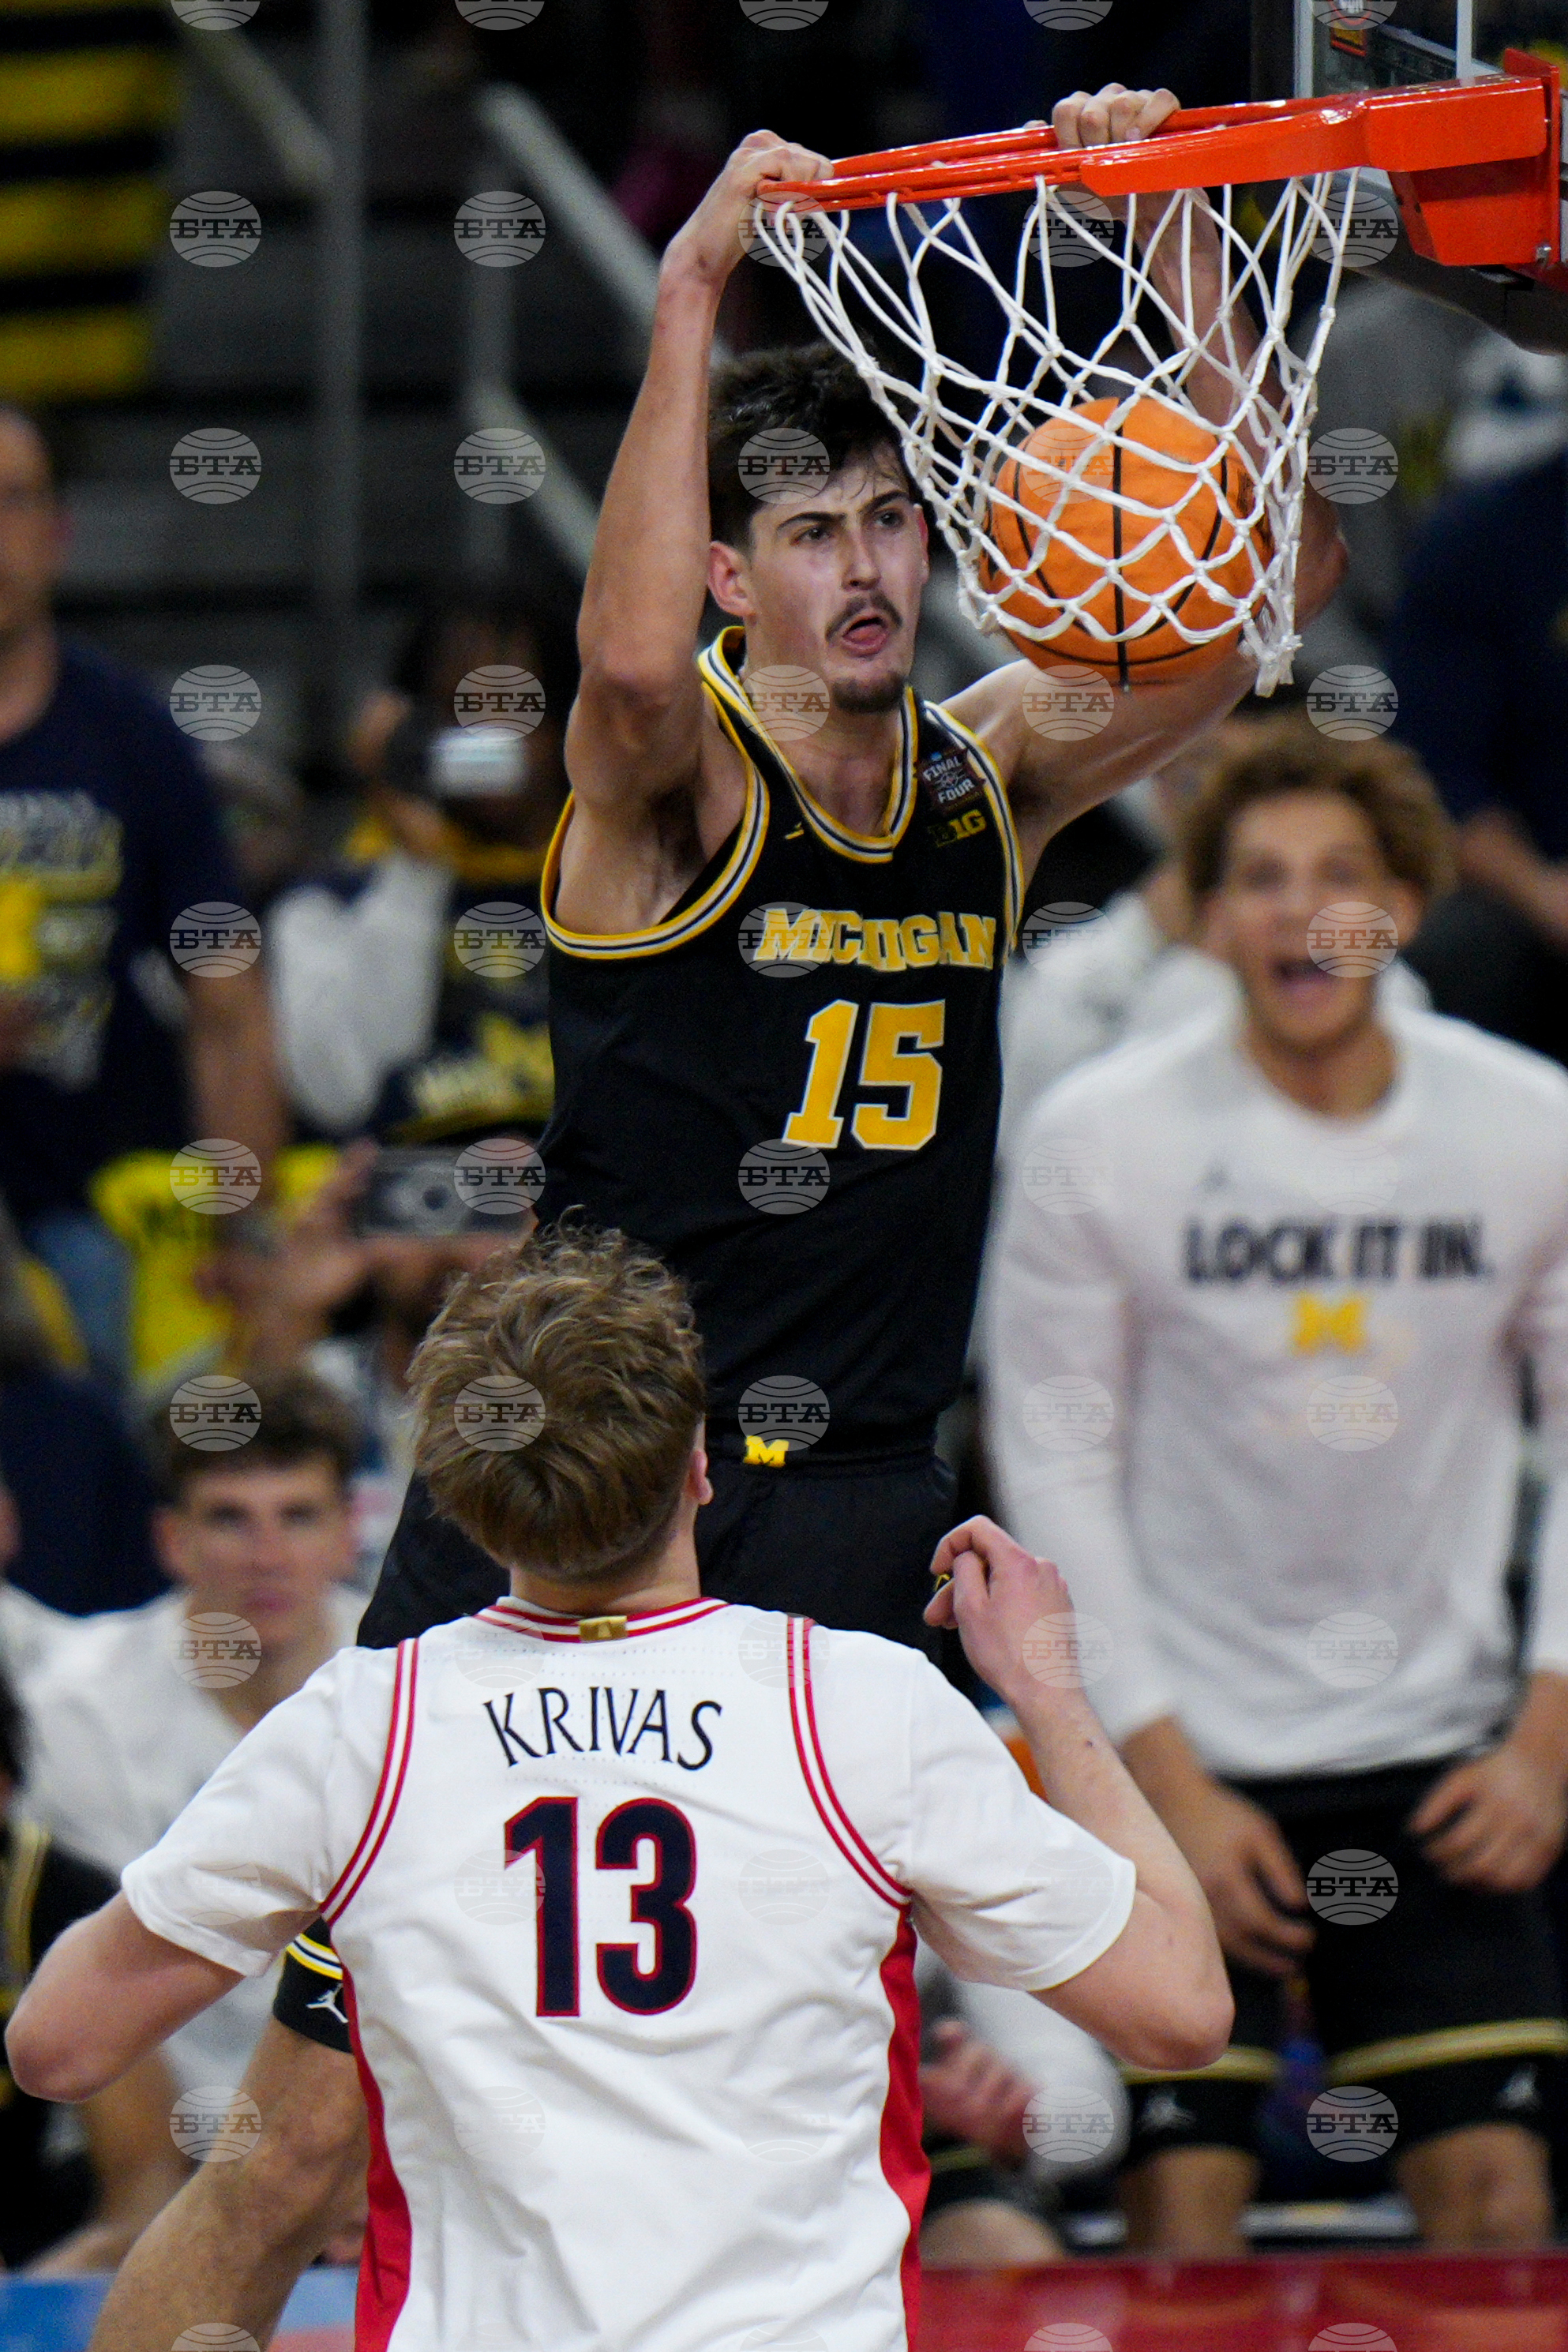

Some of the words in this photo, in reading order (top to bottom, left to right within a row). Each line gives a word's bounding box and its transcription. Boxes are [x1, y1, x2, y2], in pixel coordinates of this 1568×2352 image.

[922, 756, 963, 782] FINAL
[937, 778, 976, 804] FOUR
[782, 998, 946, 1150] 15
[744, 1435, 789, 1468] M
[483, 1686, 722, 1771] KRIVAS
[504, 1795, 698, 2017] 13
